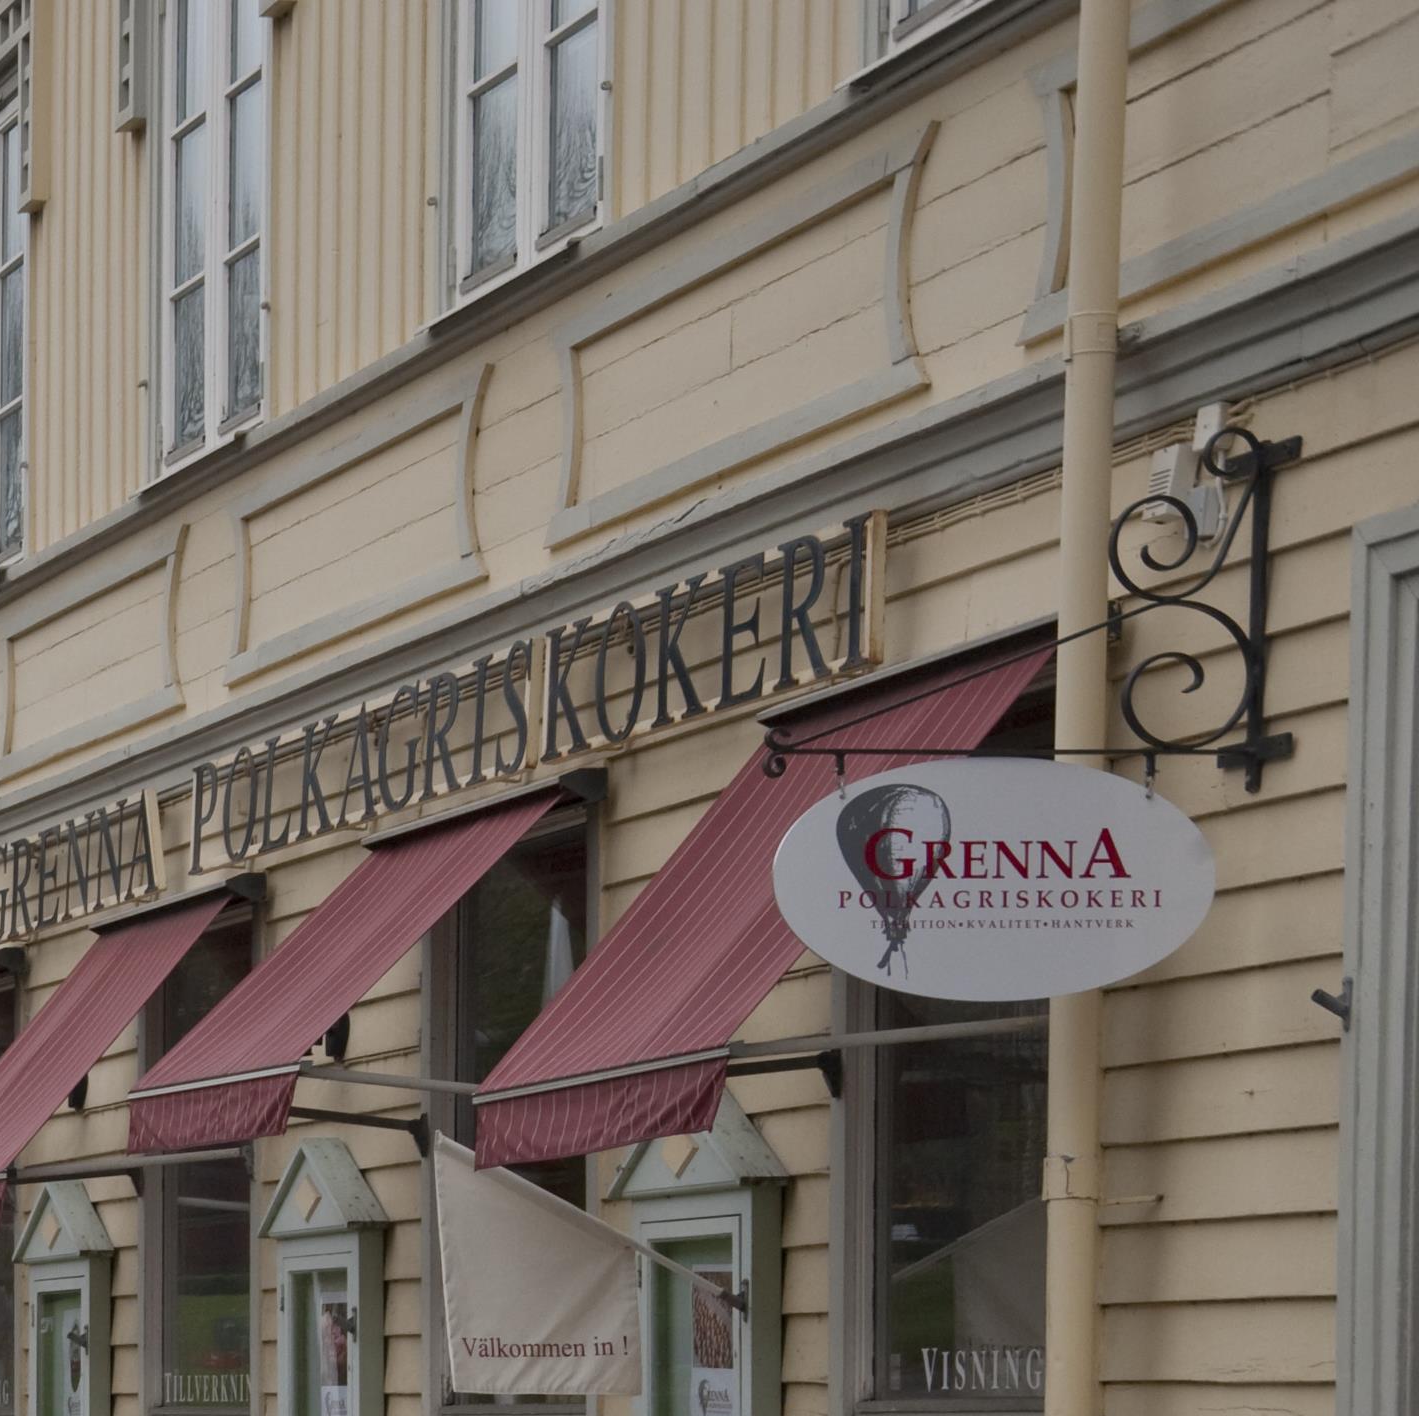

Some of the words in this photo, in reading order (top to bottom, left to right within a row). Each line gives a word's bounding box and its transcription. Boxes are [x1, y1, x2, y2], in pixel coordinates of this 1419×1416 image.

[189, 511, 869, 876] POLKAGRISKOKERI
[863, 827, 1132, 881] GRENNA
[838, 889, 1163, 909] POLKAGRISKOKERI
[462, 1336, 586, 1358] Välkommen
[593, 1336, 615, 1356] in
[921, 1347, 1043, 1393] VISNING
